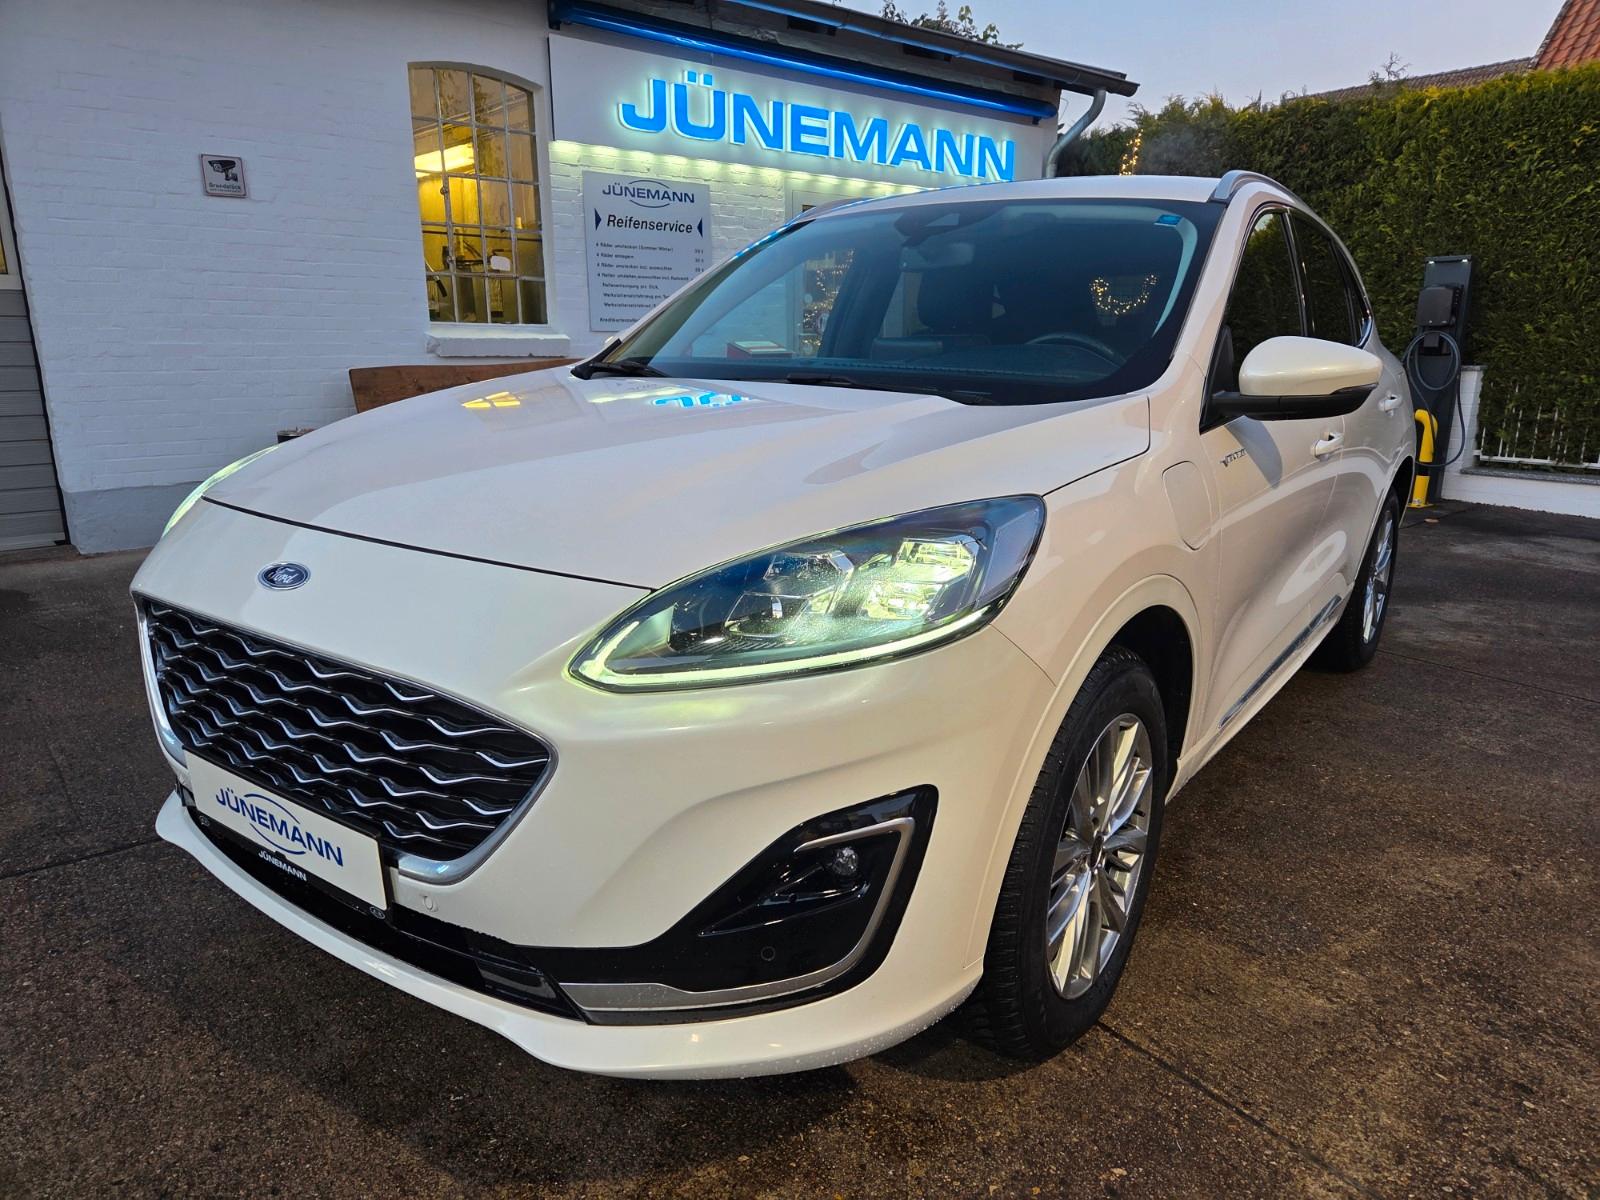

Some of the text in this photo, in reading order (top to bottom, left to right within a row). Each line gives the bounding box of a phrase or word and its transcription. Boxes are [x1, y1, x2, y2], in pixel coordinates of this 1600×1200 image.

[619, 70, 1015, 182] JÜNEMANN
[602, 182, 695, 204] JÜNEMANN
[607, 214, 693, 234] Reifenservice
[267, 566, 299, 584] Ford
[215, 787, 344, 867] JÜNEMANN
[258, 850, 308, 882] JÜNEMANN
